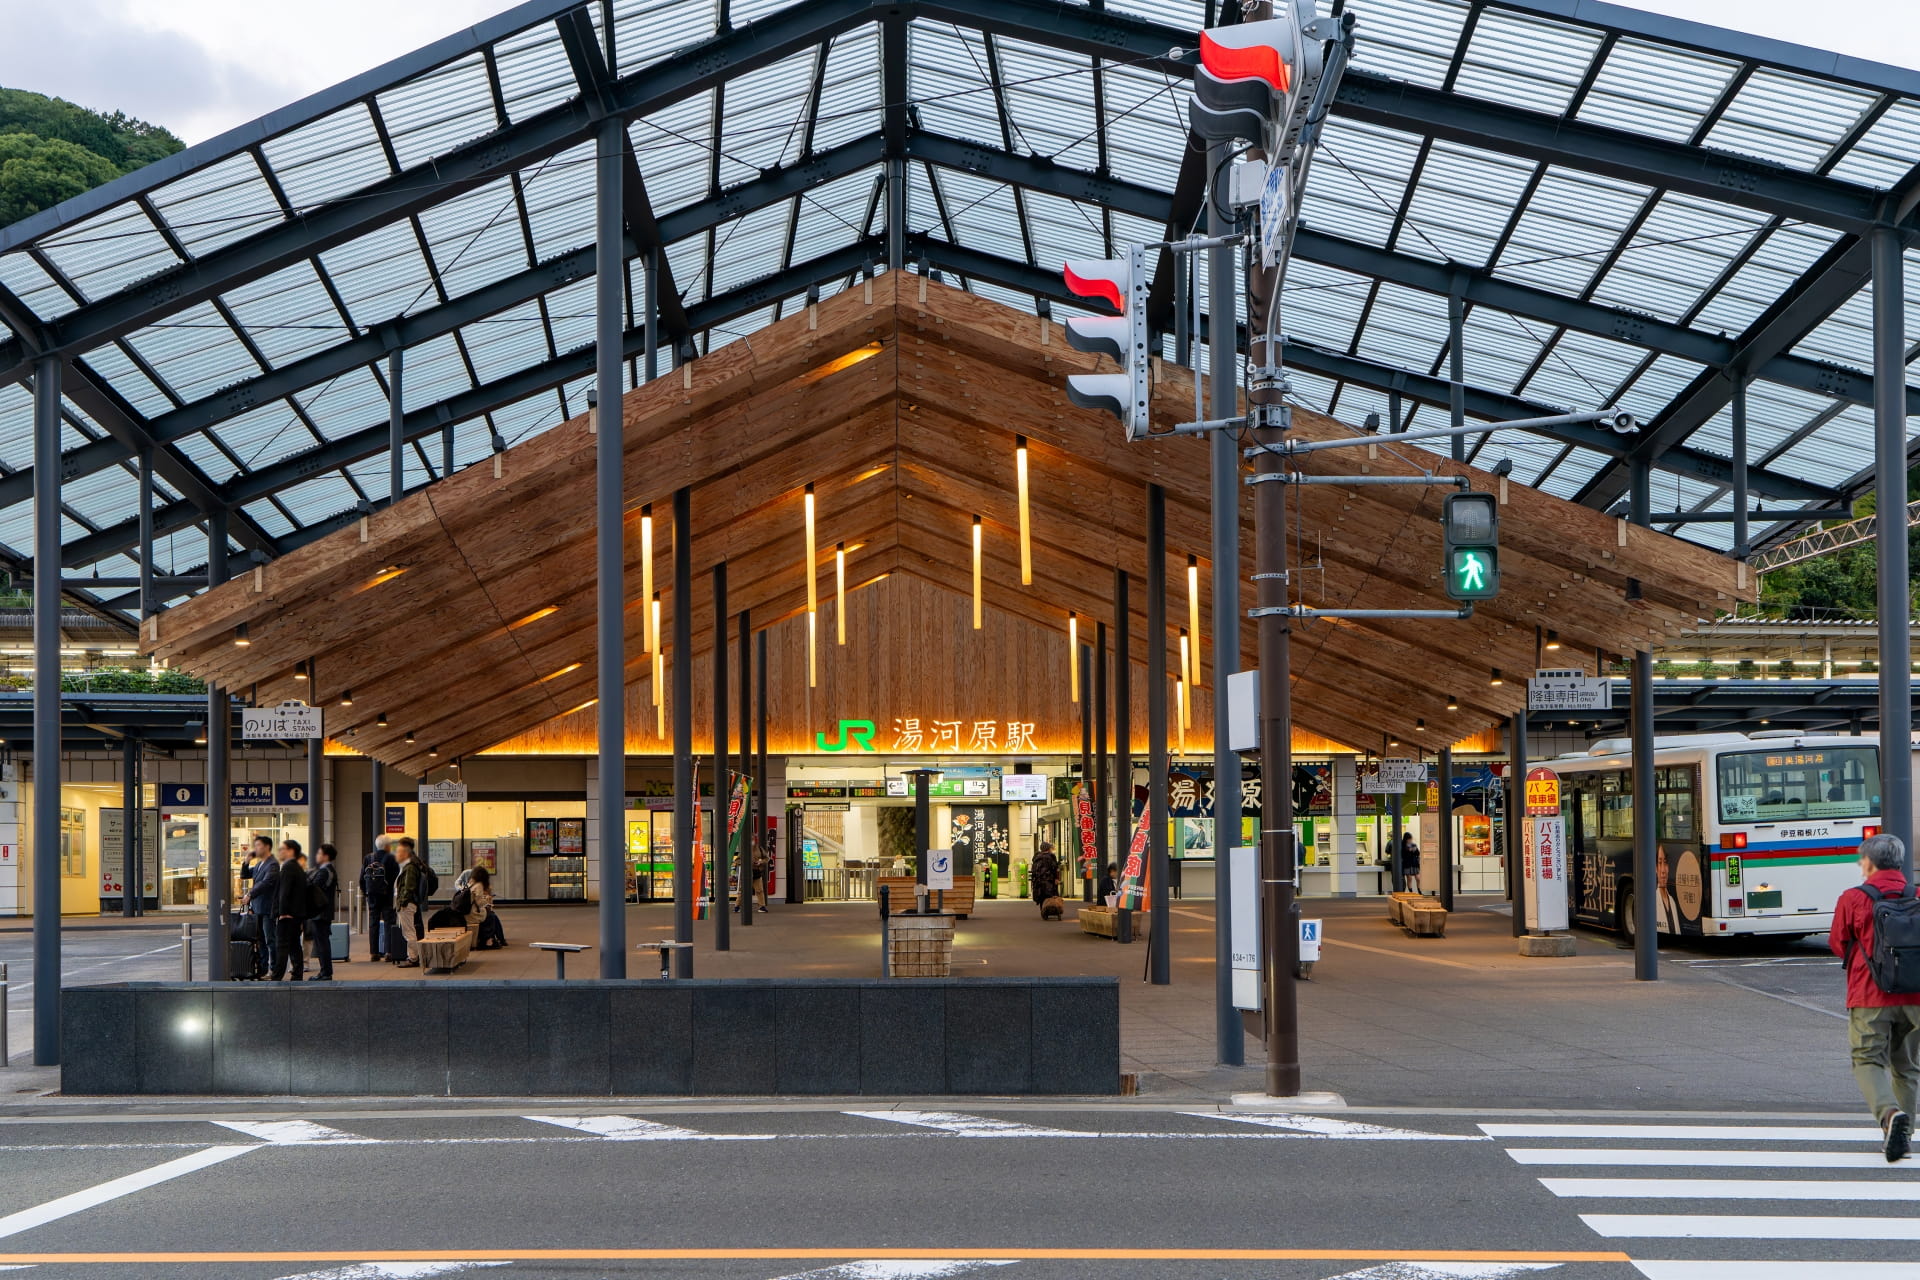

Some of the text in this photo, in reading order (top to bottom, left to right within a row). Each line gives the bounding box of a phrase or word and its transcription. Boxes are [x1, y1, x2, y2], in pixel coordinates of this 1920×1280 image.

[1598, 681, 1608, 708] 1
[245, 719, 290, 732] のりば
[816, 719, 876, 752] JR
[892, 718, 1039, 752] 湯河原駅
[1418, 764, 1426, 781] 2
[1537, 772, 1545, 780] 1
[231, 786, 272, 797] 案内所
[1529, 782, 1556, 792] バス
[1781, 828, 1829, 838] 伊豆箱根バス
[1540, 821, 1552, 879] バス降車場
[1582, 852, 1617, 912] 熱海
